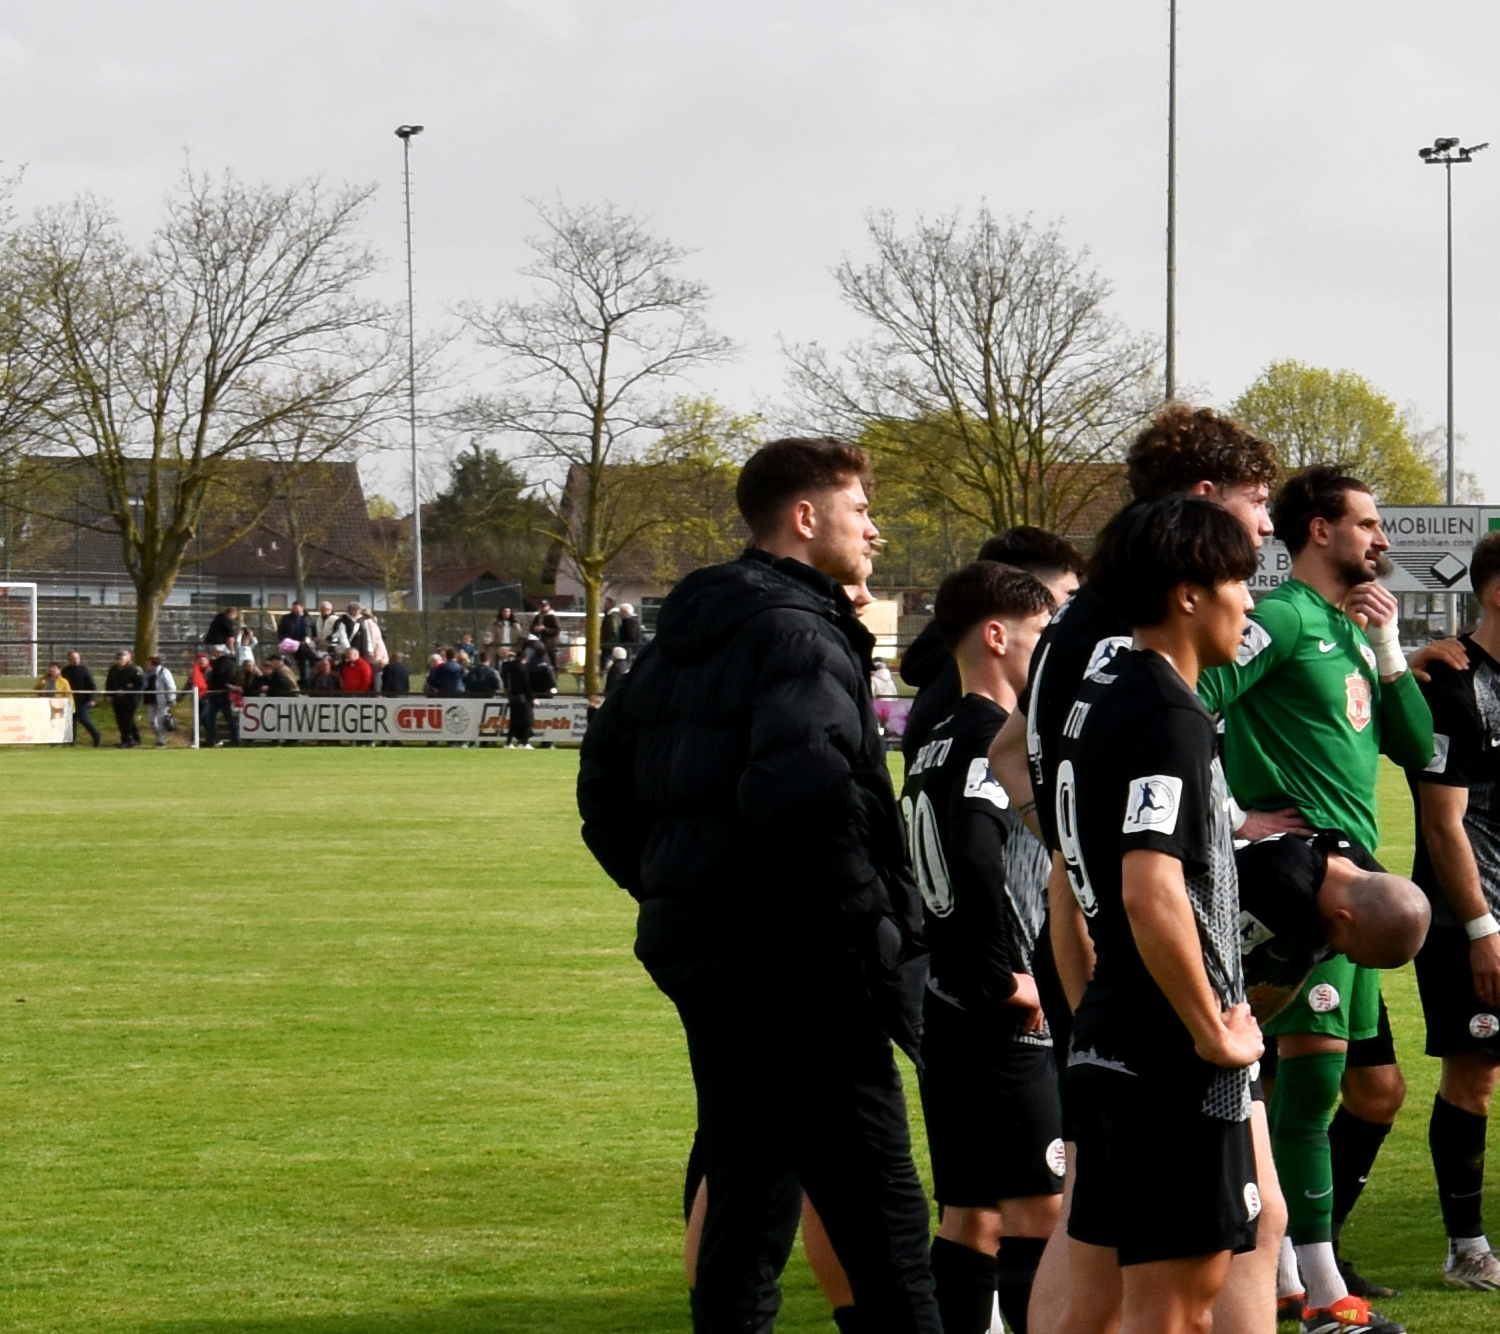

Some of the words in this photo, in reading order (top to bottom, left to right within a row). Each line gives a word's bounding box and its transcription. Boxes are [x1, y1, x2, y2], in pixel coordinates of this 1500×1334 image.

[1380, 517, 1474, 535] MOBILIEN
[243, 703, 390, 734] SCHWEIGER
[396, 704, 444, 730] GTÜ
